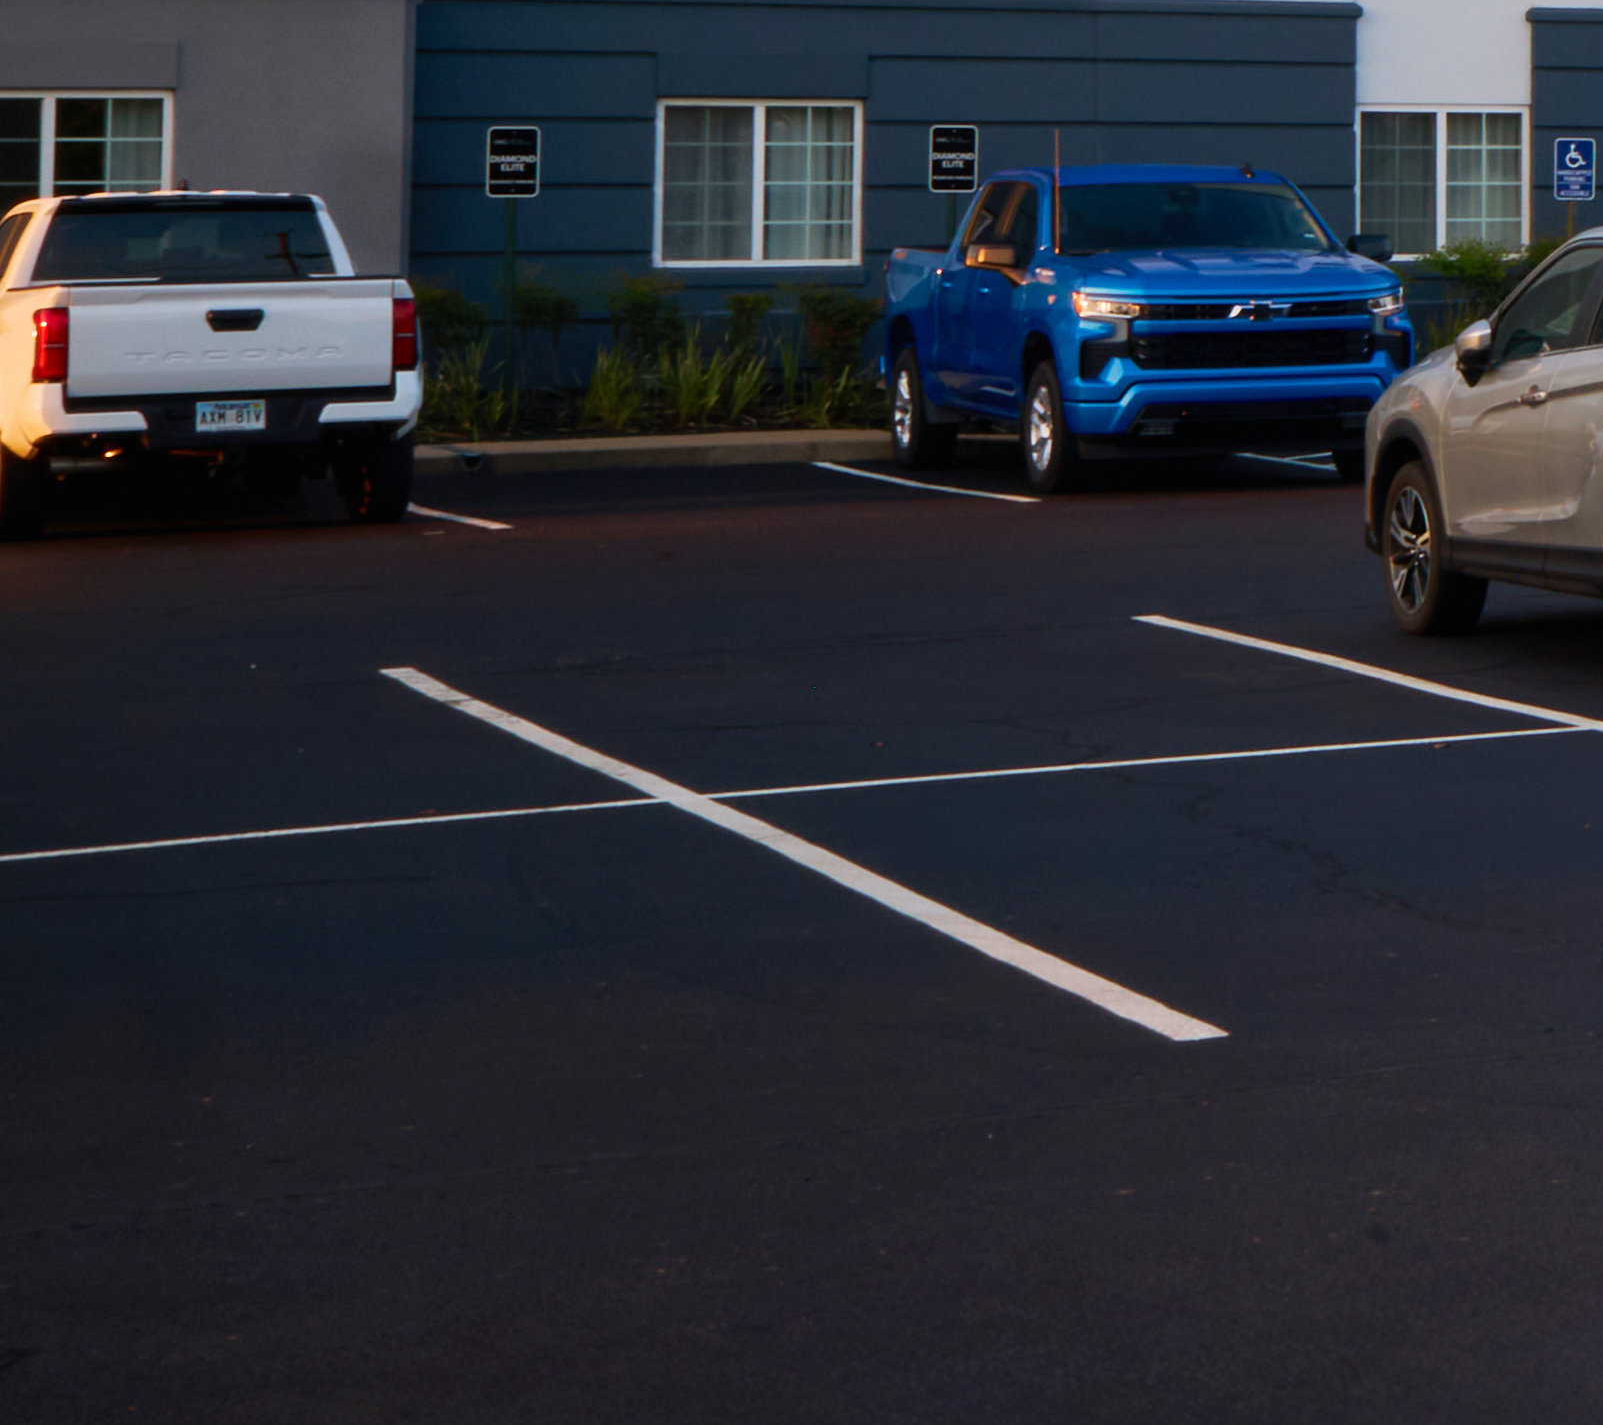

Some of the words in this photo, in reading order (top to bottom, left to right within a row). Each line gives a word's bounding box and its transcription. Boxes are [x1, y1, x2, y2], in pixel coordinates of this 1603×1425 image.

[490, 155, 537, 163] DIAMOND
[932, 152, 976, 160] DIAMOND
[500, 163, 525, 172] ELITE
[942, 160, 965, 168] ELITE
[124, 346, 345, 365] TACOMA
